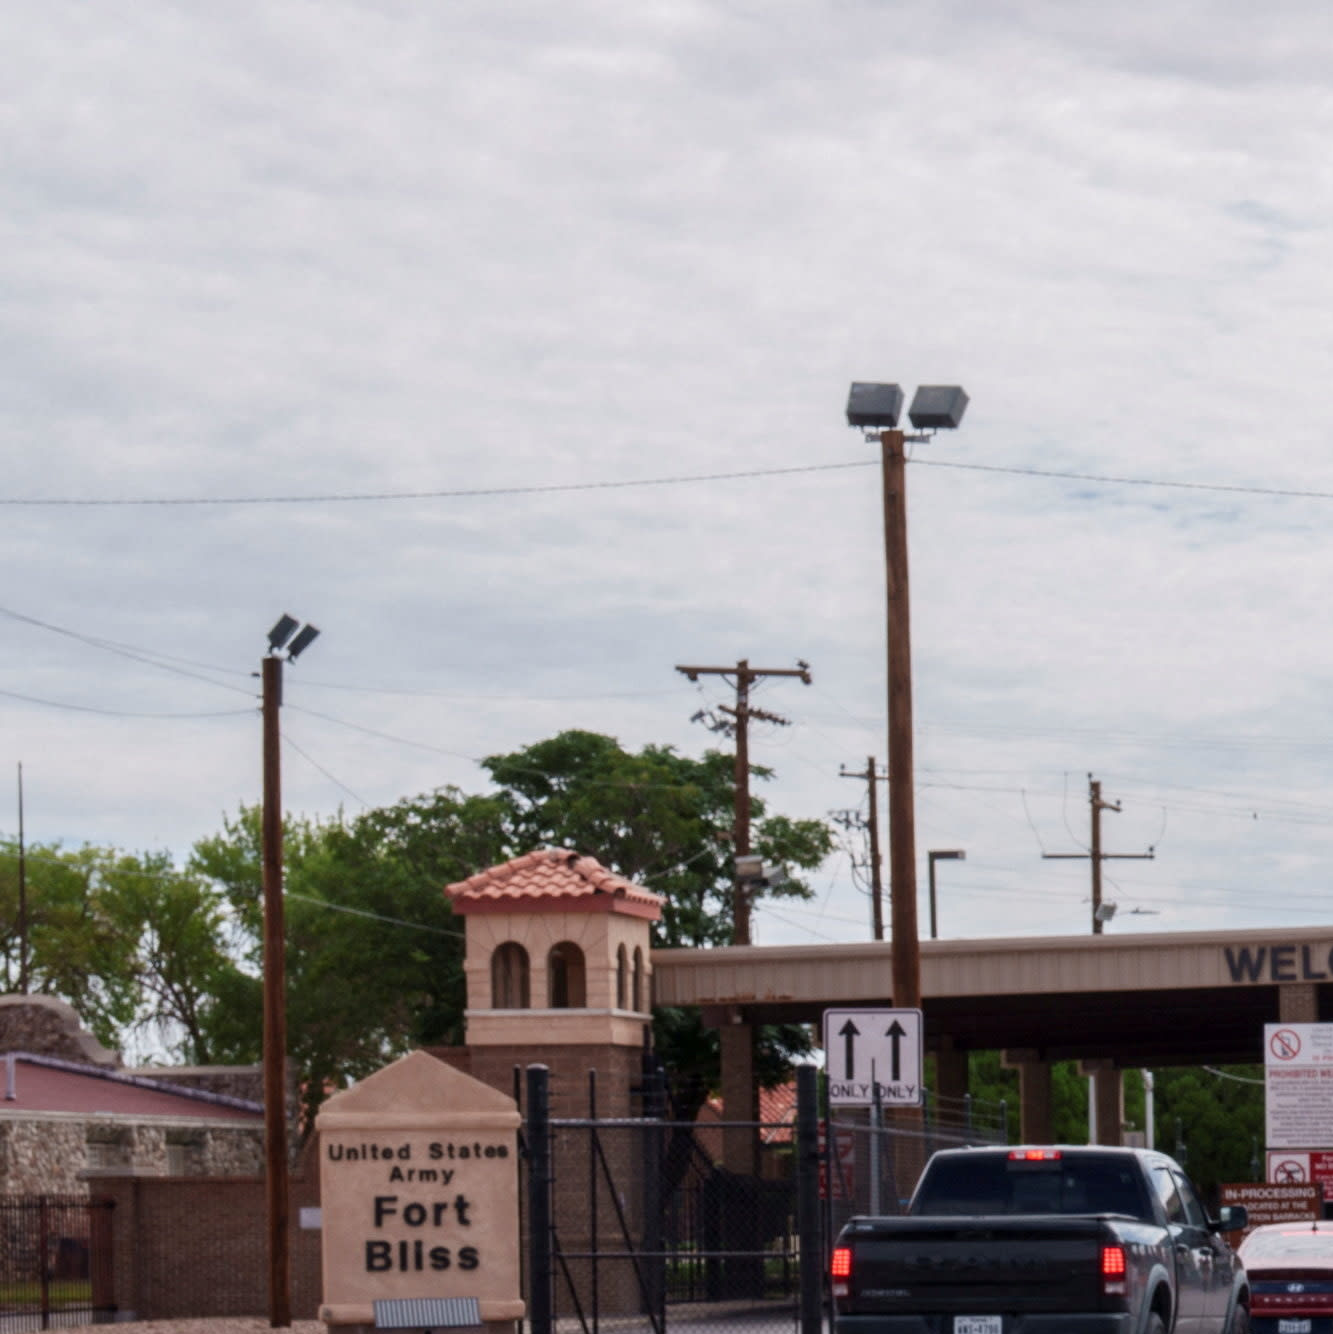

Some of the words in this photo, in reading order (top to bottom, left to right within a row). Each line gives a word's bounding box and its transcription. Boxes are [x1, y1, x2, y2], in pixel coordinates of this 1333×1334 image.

[830, 1086, 869, 1098] ONLY
[879, 1085, 916, 1098] ONLY
[327, 1143, 412, 1162] United
[429, 1142, 510, 1160] States
[388, 1165, 455, 1186] Army
[1225, 1187, 1316, 1199] IN-PROCESSING
[373, 1194, 472, 1228] Fort
[364, 1240, 481, 1272] Bliss
